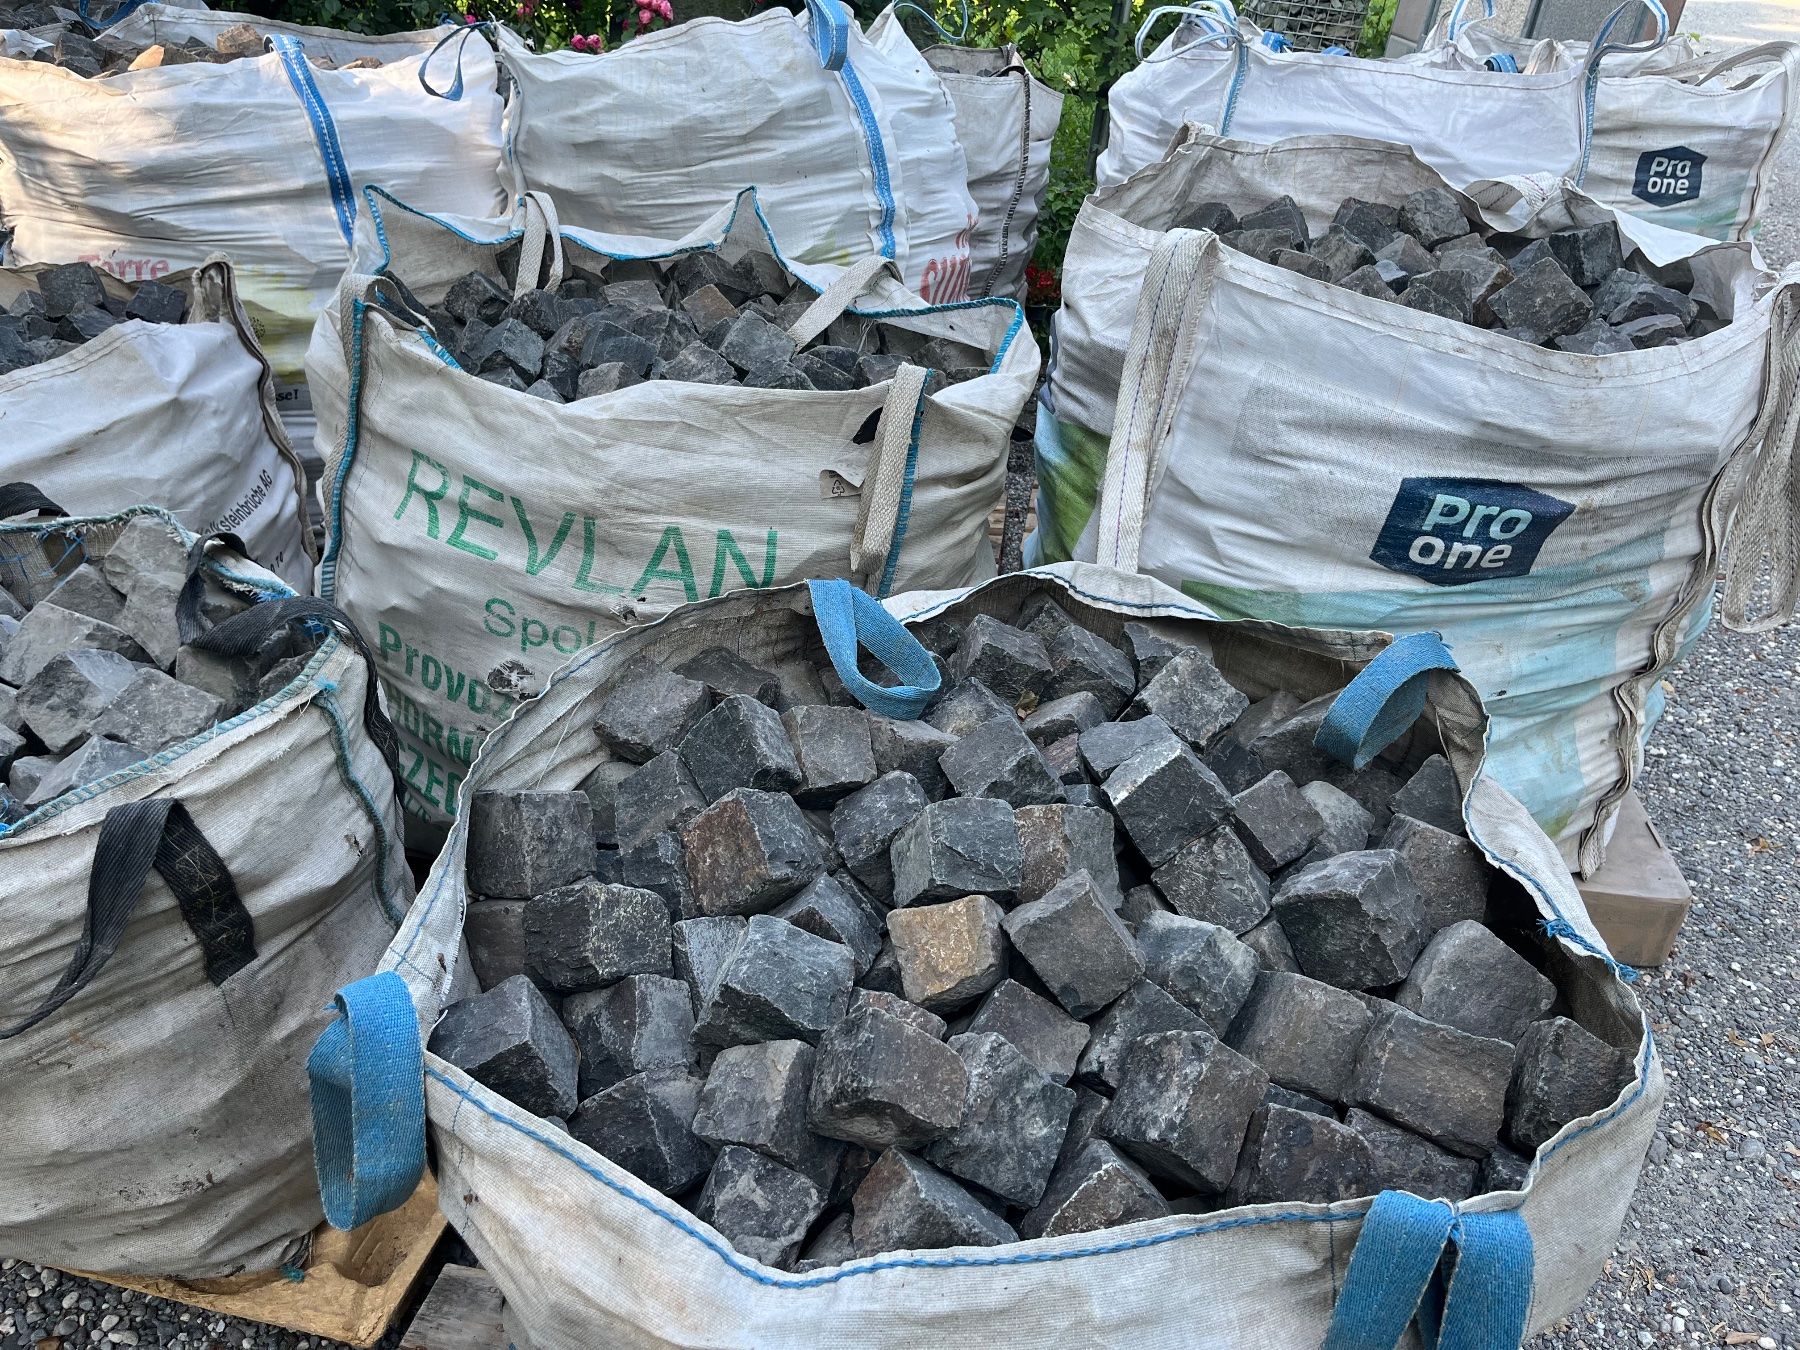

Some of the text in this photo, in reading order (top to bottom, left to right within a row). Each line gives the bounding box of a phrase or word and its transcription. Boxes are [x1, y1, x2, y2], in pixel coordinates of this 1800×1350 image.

[1649, 156, 1691, 177] Pro
[1647, 177, 1689, 194] one
[393, 448, 778, 602] REVLAN
[1422, 493, 1533, 540] Pro
[1408, 535, 1513, 569] one
